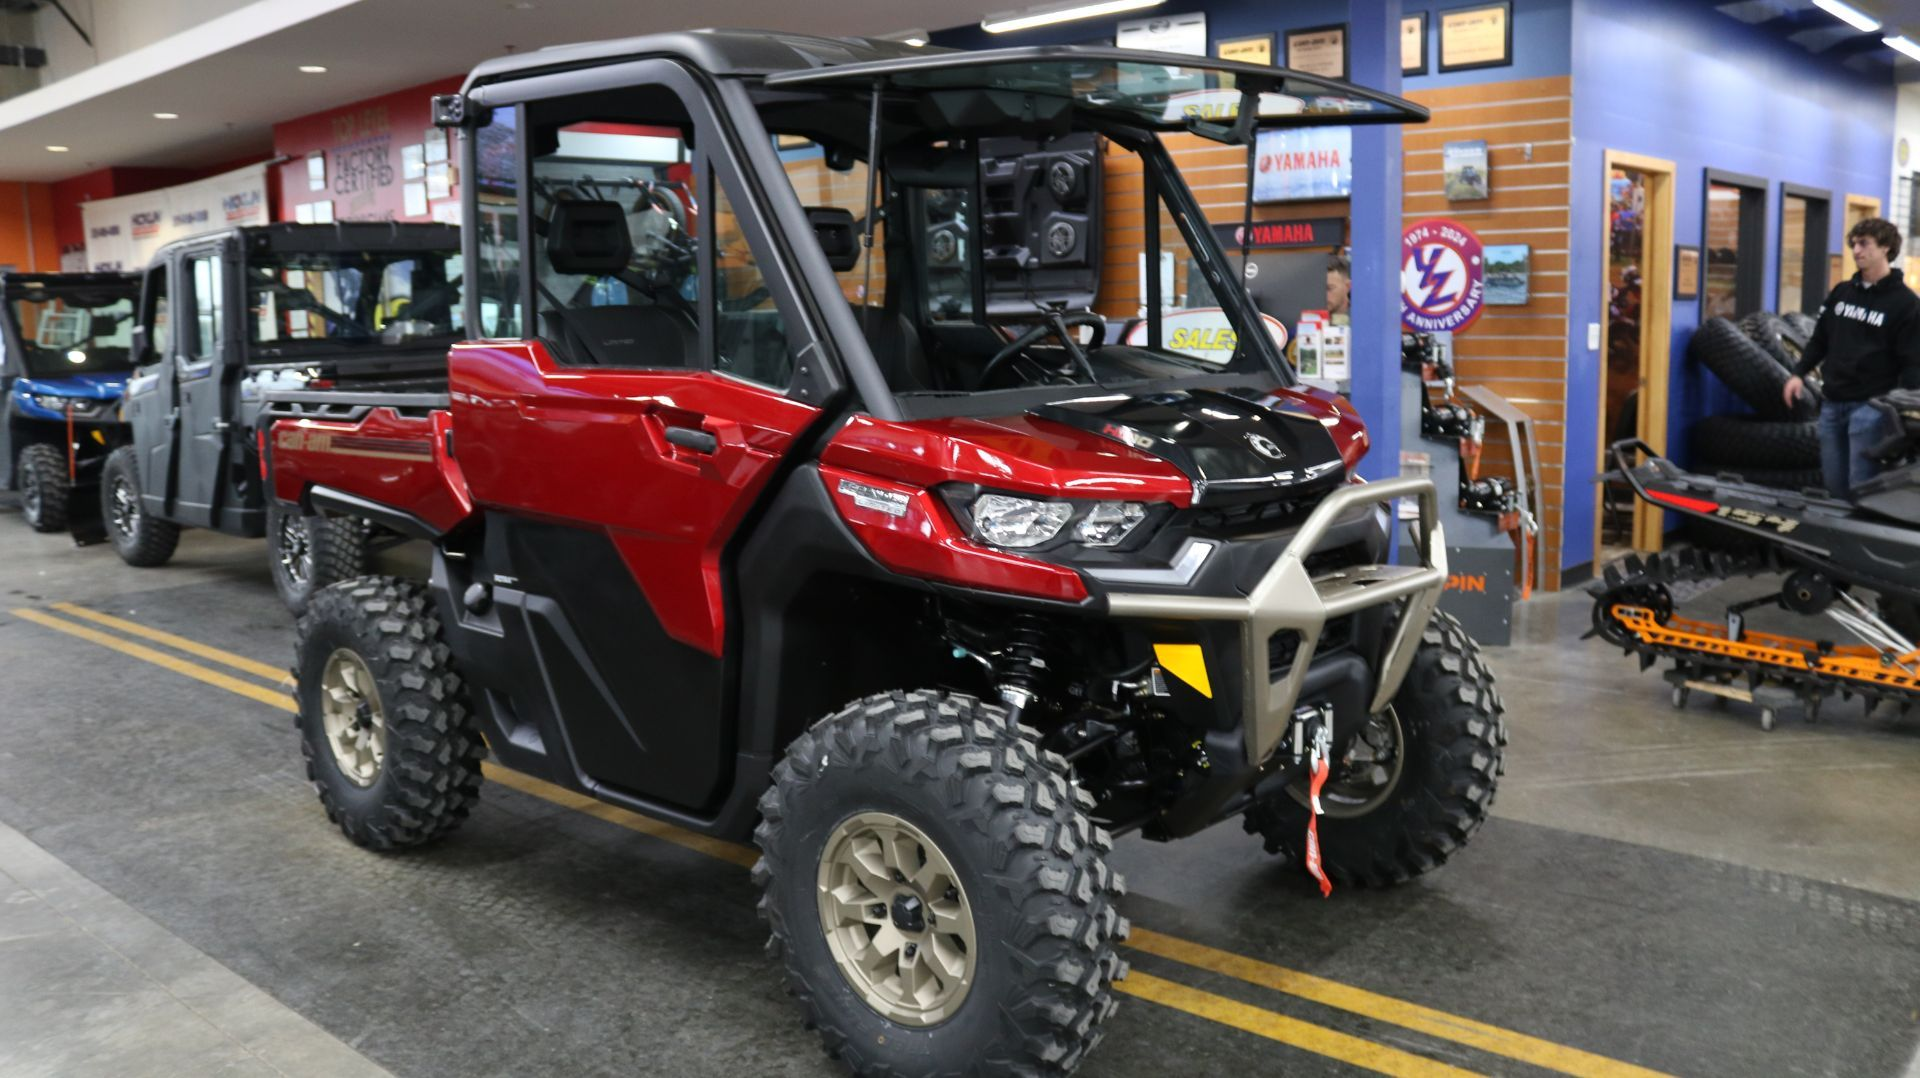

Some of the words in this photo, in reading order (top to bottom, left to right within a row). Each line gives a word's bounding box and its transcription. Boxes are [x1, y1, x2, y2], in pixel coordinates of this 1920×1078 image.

[334, 145, 390, 174] FACTORY
[1274, 149, 1341, 172] YAMAHA
[334, 163, 394, 195] CERTIFIED
[1253, 223, 1315, 244] YAMAHA
[1404, 225, 1430, 247] 1974
[1440, 225, 1468, 247] 2024
[1406, 278, 1483, 330] ANNIVERSARY
[1169, 327, 1238, 350] SALES
